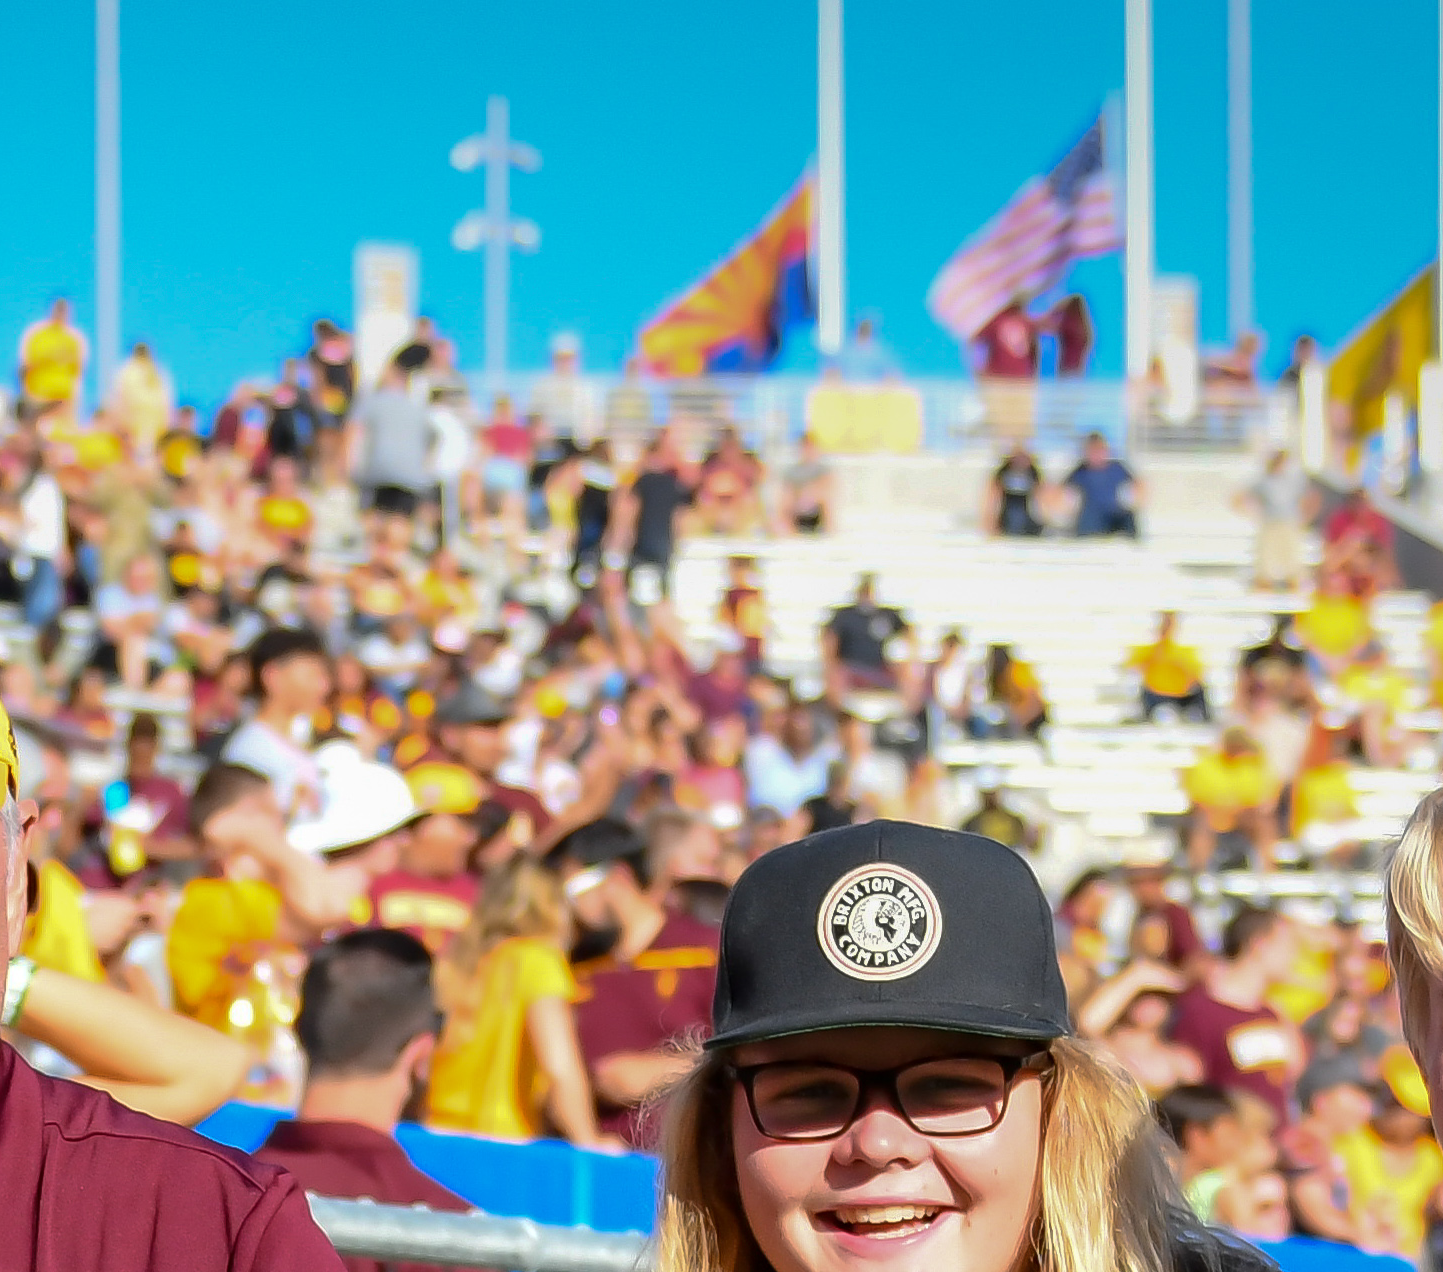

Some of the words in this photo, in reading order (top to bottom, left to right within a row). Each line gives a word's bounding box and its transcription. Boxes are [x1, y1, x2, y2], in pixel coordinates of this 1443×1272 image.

[833, 878, 895, 926] BRIXTON
[896, 886, 926, 925] MFG.
[838, 932, 921, 967] COMPANY
